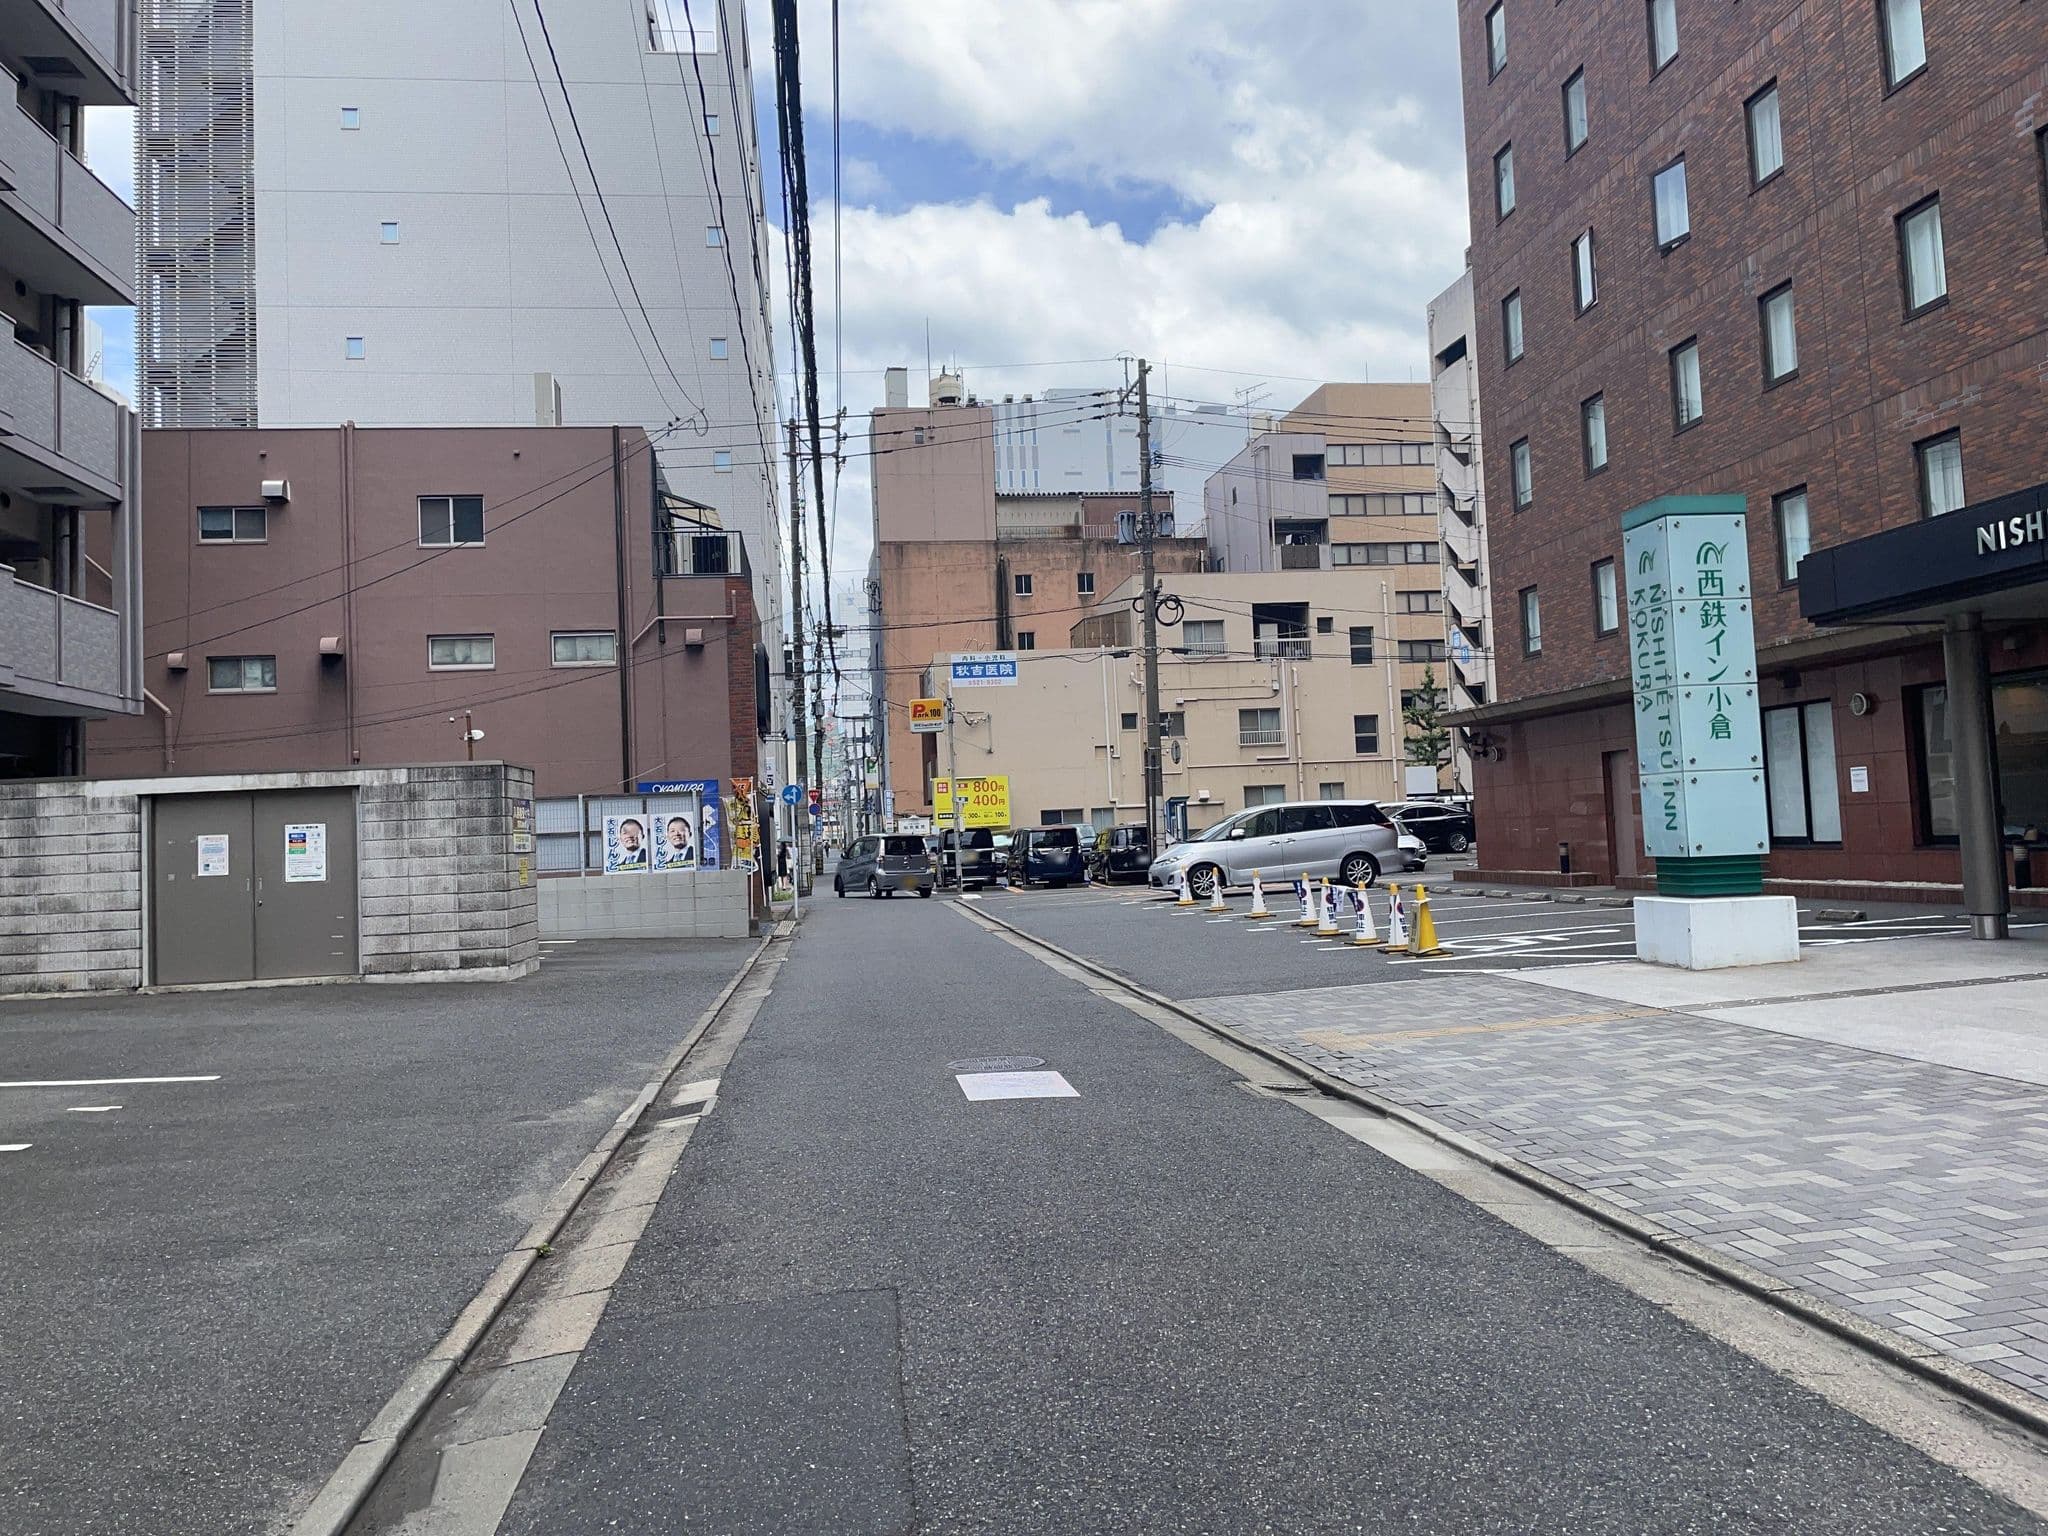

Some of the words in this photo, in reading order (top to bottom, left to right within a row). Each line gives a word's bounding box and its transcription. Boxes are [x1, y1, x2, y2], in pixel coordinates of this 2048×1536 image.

[1977, 508, 2048, 555] NISH
[1634, 589, 1653, 712] KOKURA
[1697, 570, 1732, 740] 西鉄イン小倉
[955, 664, 1014, 677] 秋吉医院
[930, 708, 941, 717] 100
[1649, 583, 1674, 769] NISHITETSU
[1662, 782, 1677, 831] INN
[973, 781, 1005, 793] 800円
[973, 795, 1006, 806] 400円
